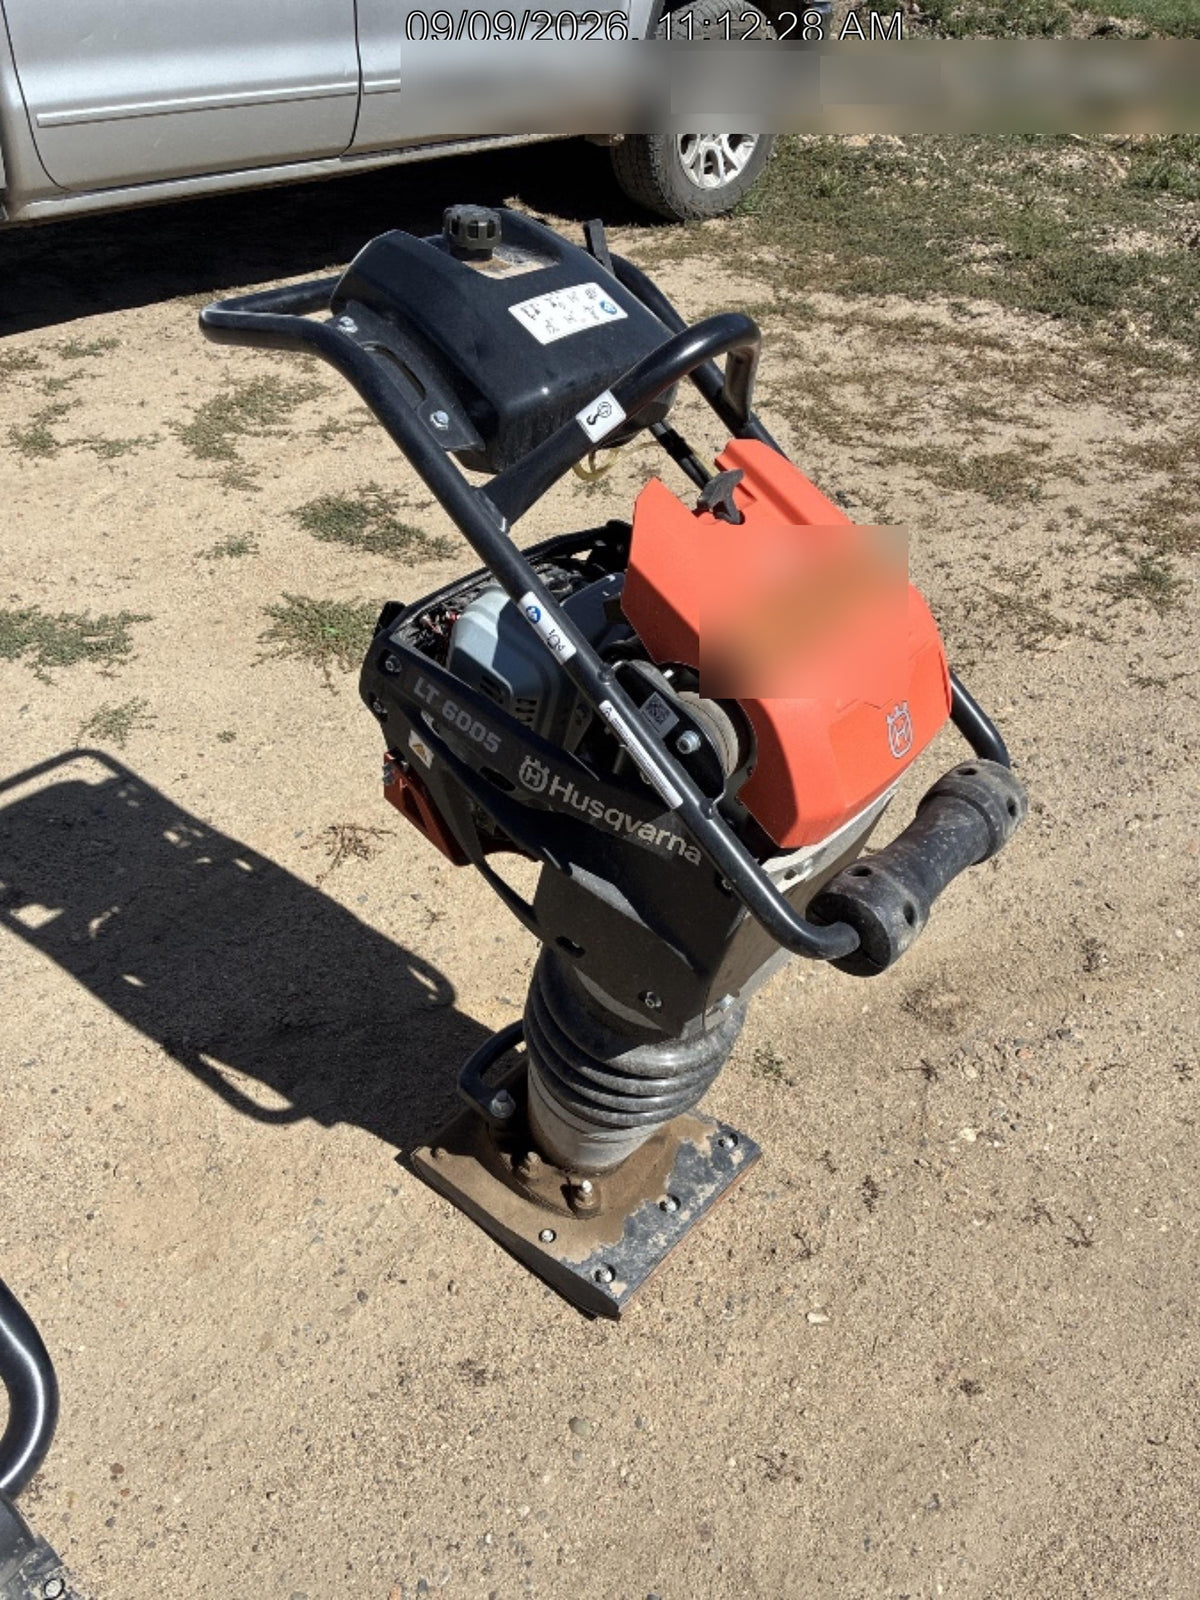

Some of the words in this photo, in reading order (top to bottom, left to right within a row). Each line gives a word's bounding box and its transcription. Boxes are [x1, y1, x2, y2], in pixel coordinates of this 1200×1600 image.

[413, 676, 440, 705] LT
[441, 699, 502, 753] 6005
[548, 774, 702, 867] Husqvarna
